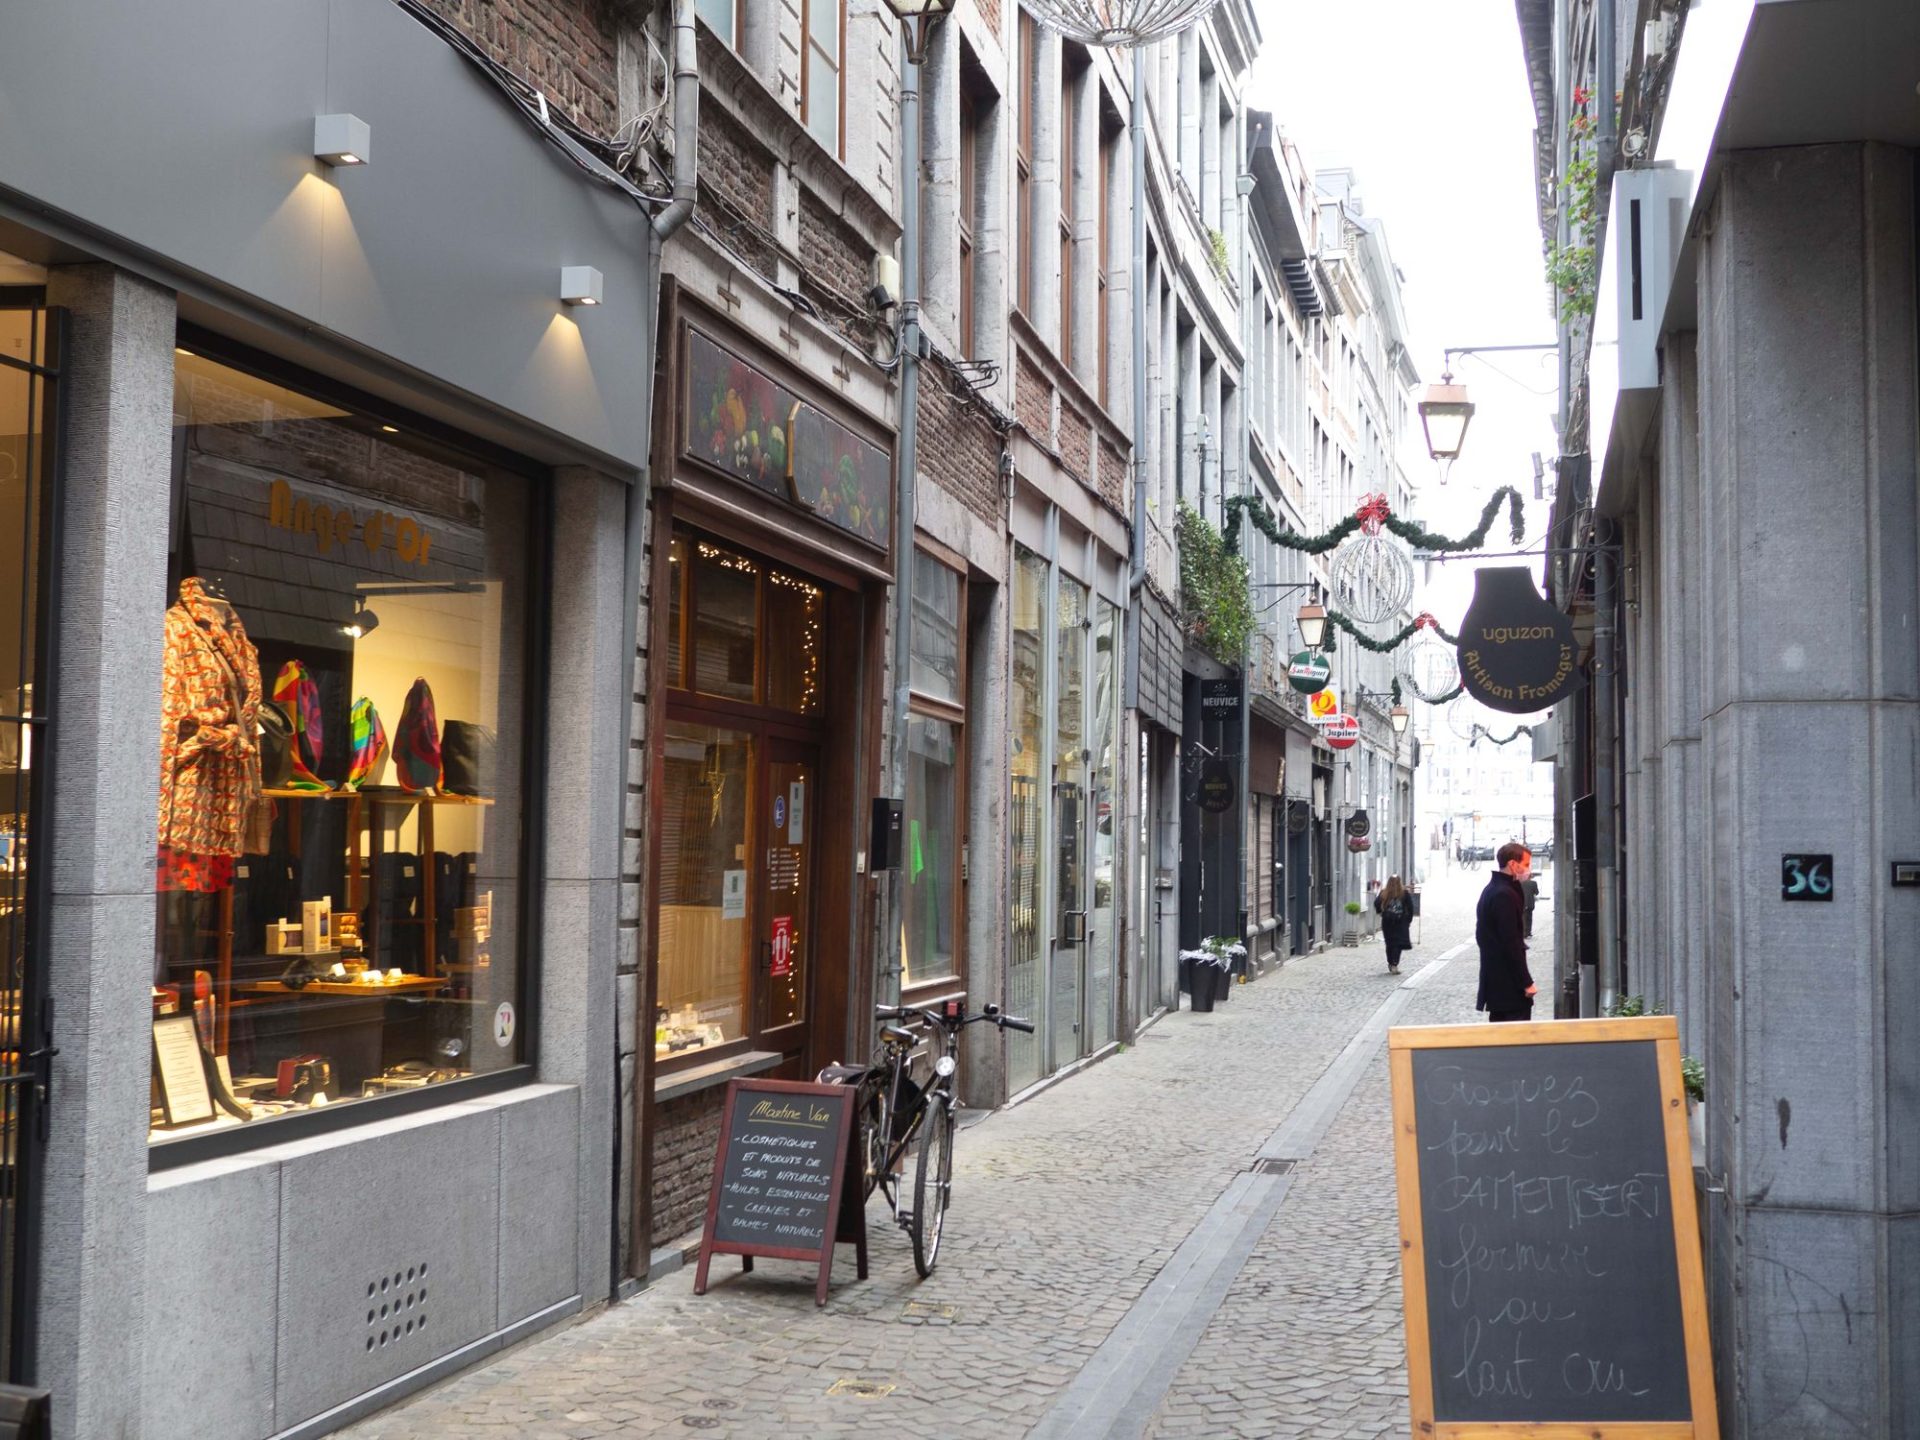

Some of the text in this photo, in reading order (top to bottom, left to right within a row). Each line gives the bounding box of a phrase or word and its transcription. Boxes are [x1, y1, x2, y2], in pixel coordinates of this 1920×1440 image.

[1482, 626, 1554, 644] uguzon
[1464, 644, 1572, 700] Artisan Fromager
[1203, 697, 1238, 706] NEUVICE
[1327, 729, 1357, 737] Jupiler
[1784, 859, 1831, 894] 36
[749, 1100, 830, 1122] Martine Van
[742, 1151, 758, 1161] ET
[776, 1170, 830, 1186] NATURELS
[797, 1208, 815, 1217] ET
[775, 1224, 824, 1238] NATURELS
